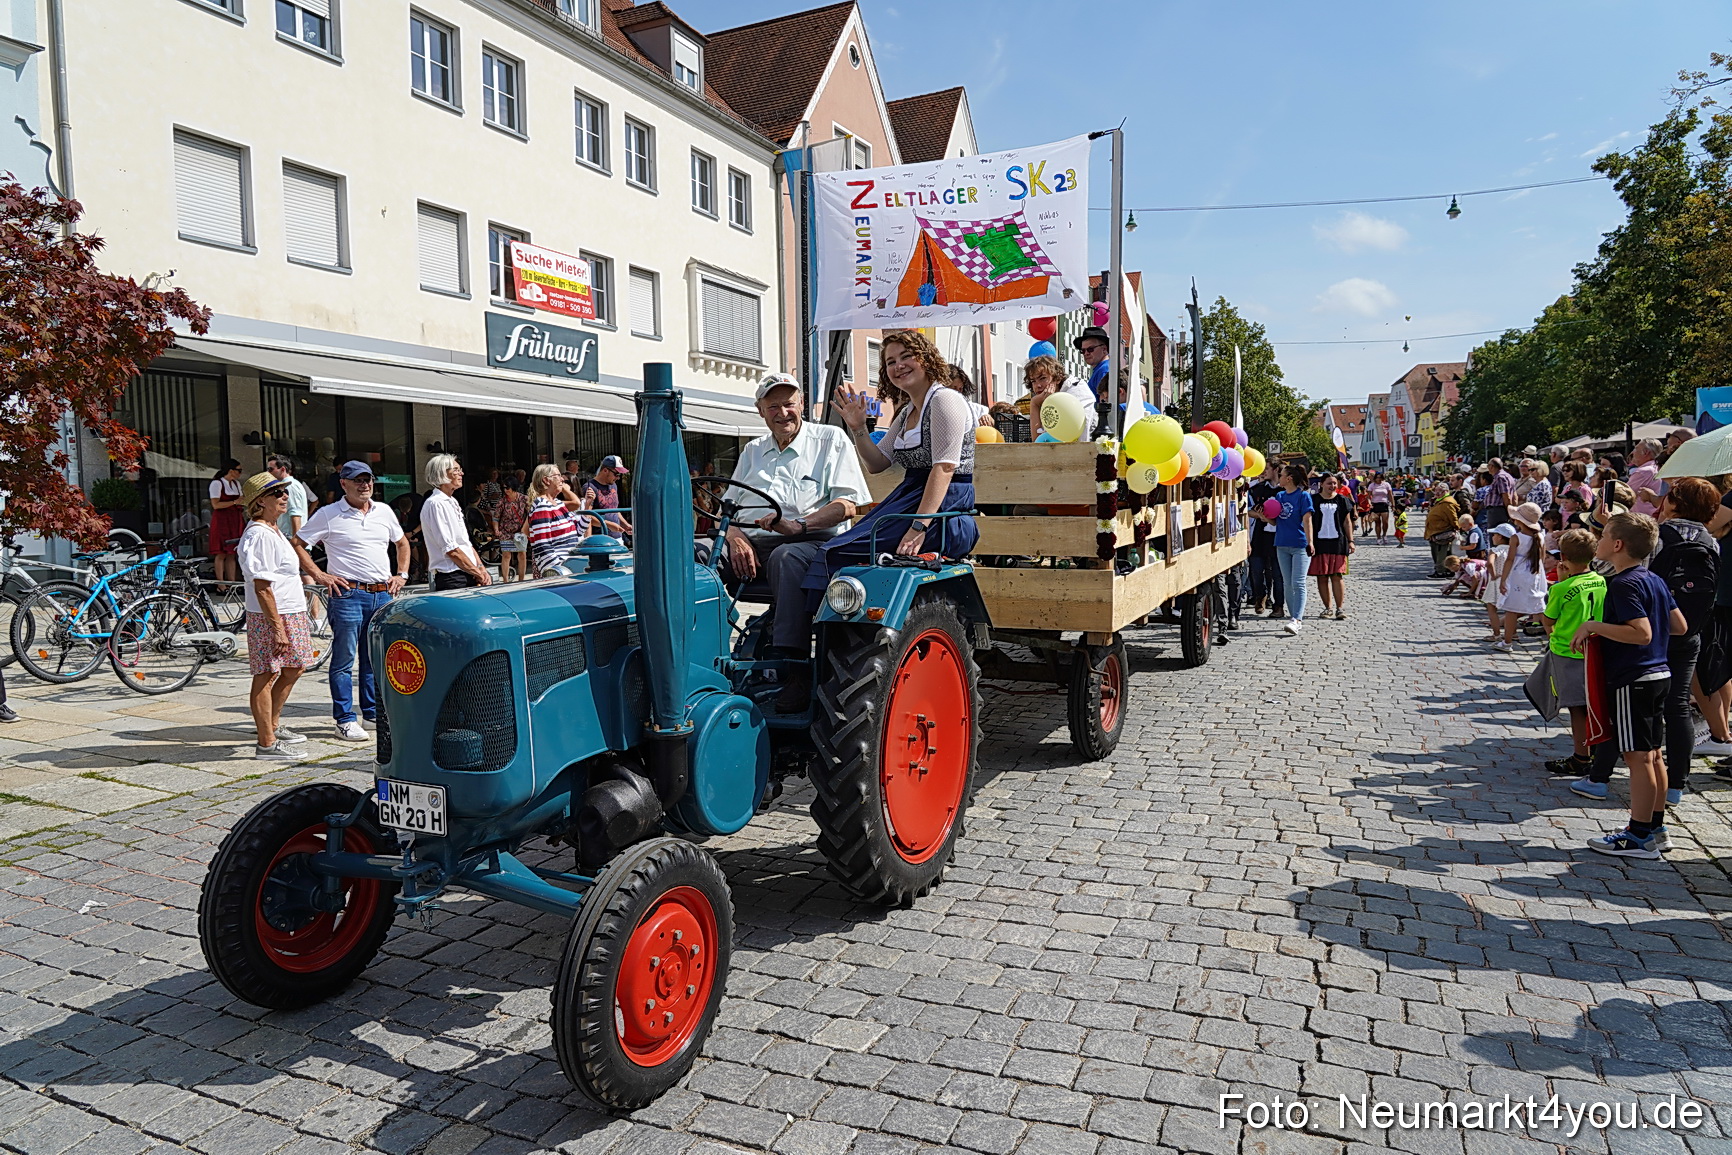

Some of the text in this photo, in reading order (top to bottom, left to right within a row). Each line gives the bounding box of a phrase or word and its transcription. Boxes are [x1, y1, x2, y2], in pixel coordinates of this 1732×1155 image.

[846, 180, 979, 210] ZELTLAGER
[515, 249, 588, 280] Suche Mieter!
[549, 299, 566, 309] 09181
[495, 323, 596, 374] frühauf
[1563, 579, 1606, 602] DEUTSCHLA
[1587, 591, 1595, 621] 1
[391, 660, 417, 674] LANZ
[389, 782, 410, 806] NM
[380, 802, 401, 825] GN
